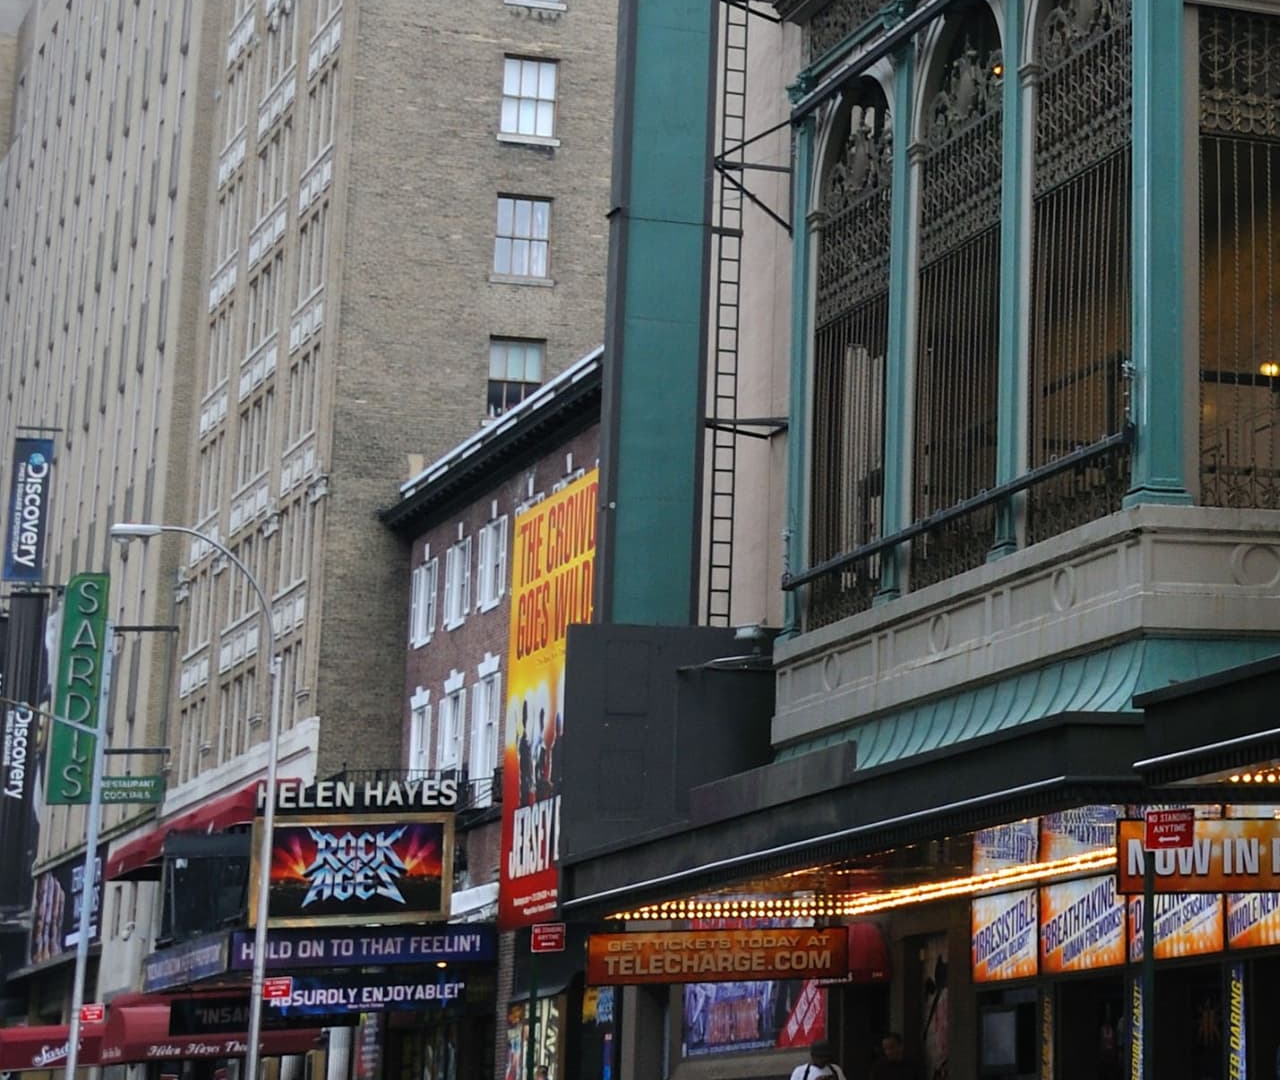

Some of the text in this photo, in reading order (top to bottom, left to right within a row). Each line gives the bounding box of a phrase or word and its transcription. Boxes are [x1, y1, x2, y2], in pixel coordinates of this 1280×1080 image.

[14, 461, 48, 568] Discovery
[516, 580, 551, 660] GOES
[4, 710, 33, 800] Discovery
[364, 779, 458, 807] HAYES
[508, 798, 554, 880] JERSEY
[1153, 824, 1186, 834] ANYTIME
[303, 825, 409, 876] ROCK
[1223, 837, 1259, 875] IN
[301, 867, 407, 908] AGES
[241, 941, 292, 960] HLD
[298, 939, 325, 957] ON
[330, 938, 354, 956] TO
[360, 936, 404, 955] THAT
[604, 950, 832, 976] TELECHARGE.COM
[608, 935, 830, 953] GET TICKETS TODAY AT
